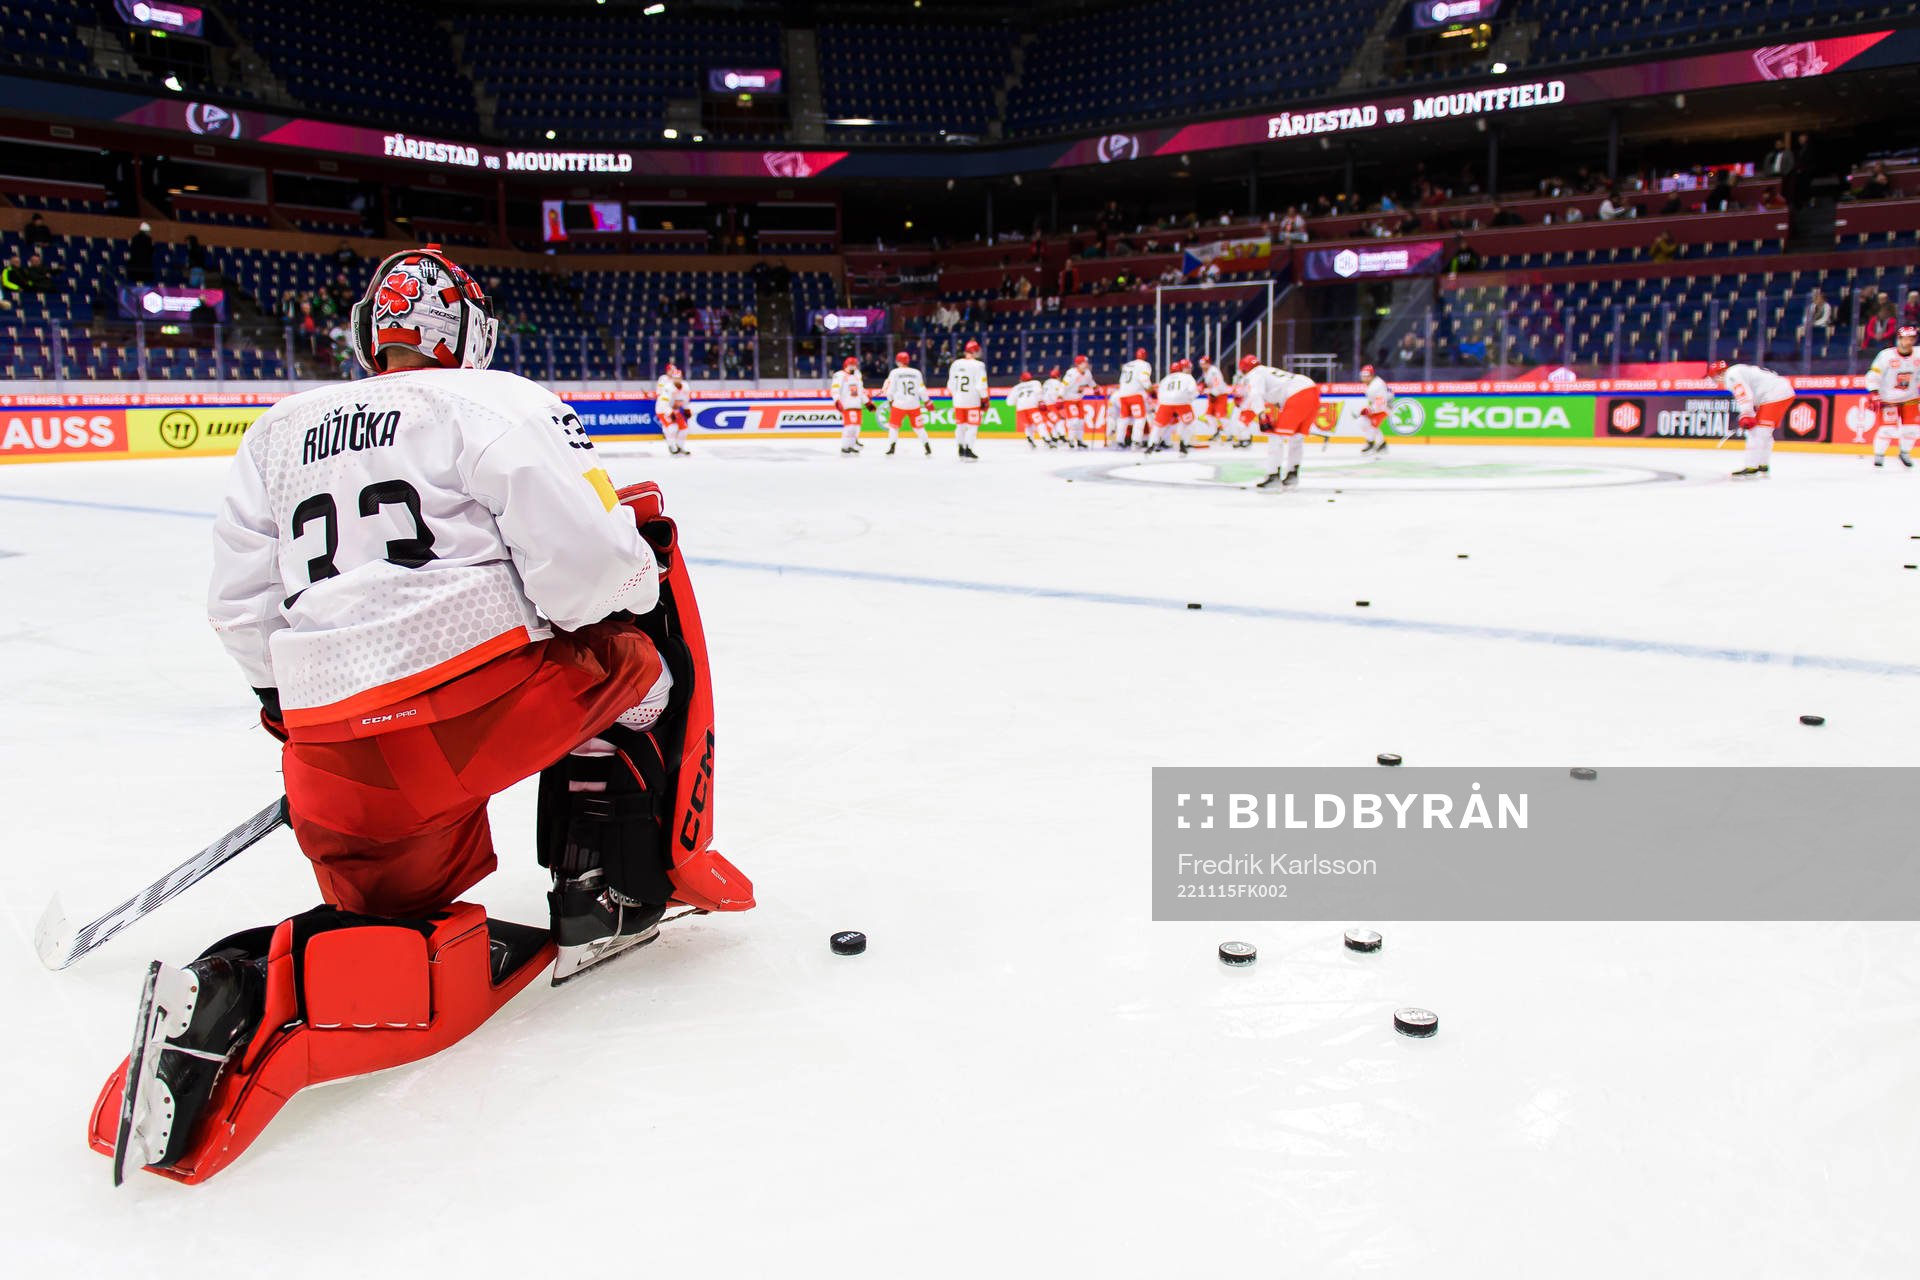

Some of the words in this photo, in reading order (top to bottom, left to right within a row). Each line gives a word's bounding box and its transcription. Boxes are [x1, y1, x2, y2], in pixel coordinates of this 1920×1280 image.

[1412, 80, 1566, 121] MOUNTFIELD
[506, 152, 633, 173] MOUNTFIELD
[902, 381, 916, 396] 12
[598, 413, 652, 426] BANKING
[1434, 402, 1571, 429] ŠKODA
[1657, 410, 1731, 437] OFFICIAL
[303, 403, 401, 466] RŮŽIČKA
[284, 479, 440, 610] 33
[361, 714, 393, 725] CCM
[396, 708, 417, 719] PRO
[680, 729, 715, 852] CCM
